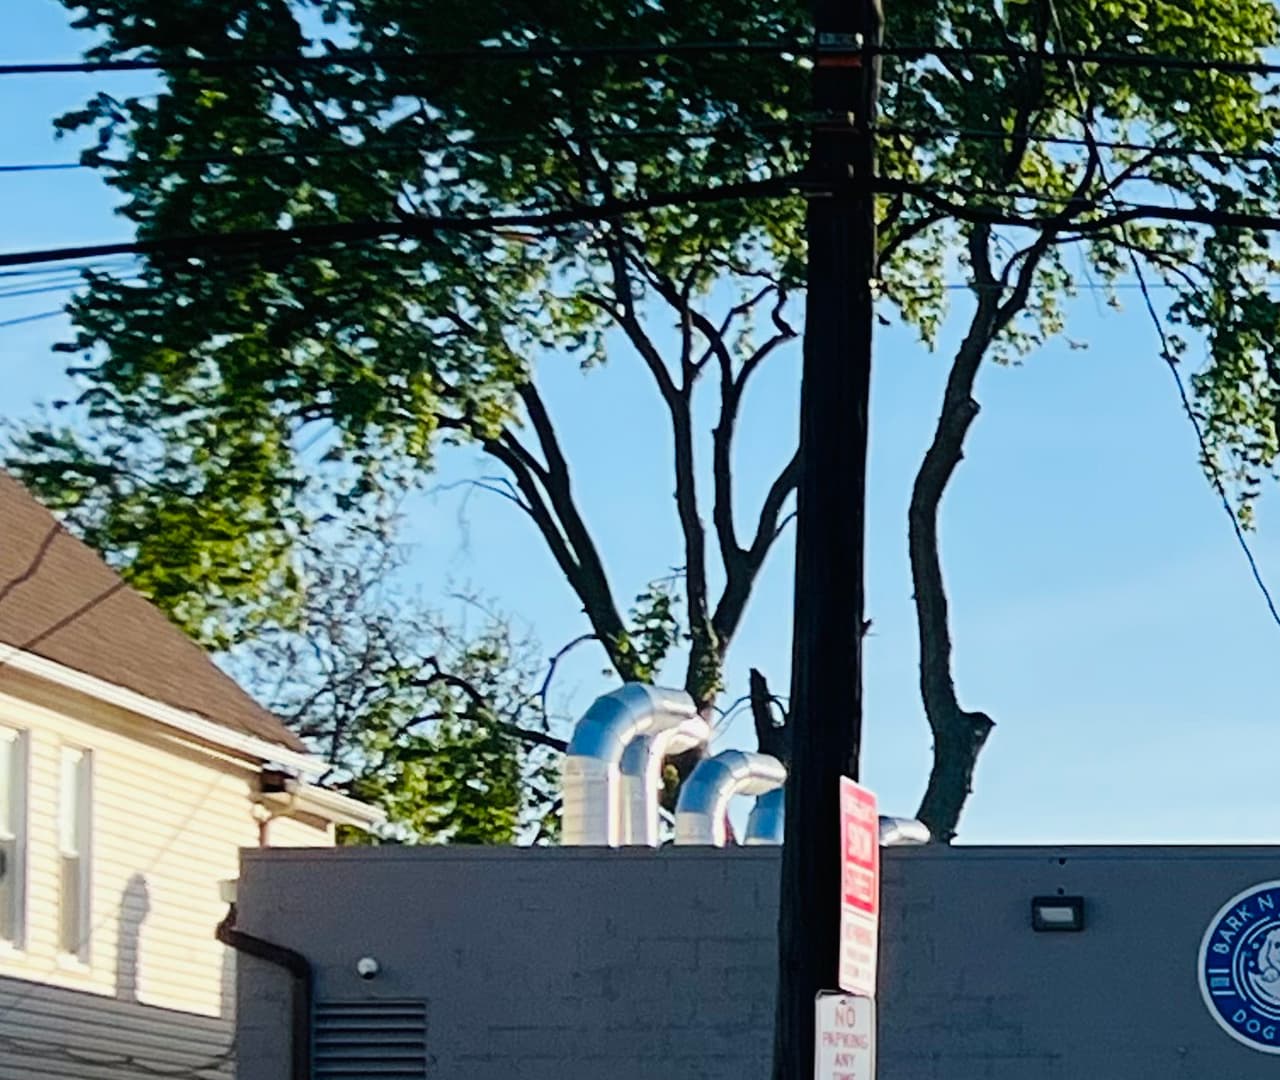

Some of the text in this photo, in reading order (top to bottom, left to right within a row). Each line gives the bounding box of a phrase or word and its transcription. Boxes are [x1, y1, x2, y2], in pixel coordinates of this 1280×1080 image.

[1212, 903, 1255, 955] BARK
[835, 1006, 856, 1028] NO
[1232, 1008, 1275, 1041] DOG
[822, 1031, 868, 1050] PARKING
[834, 1053, 856, 1068] ANY
